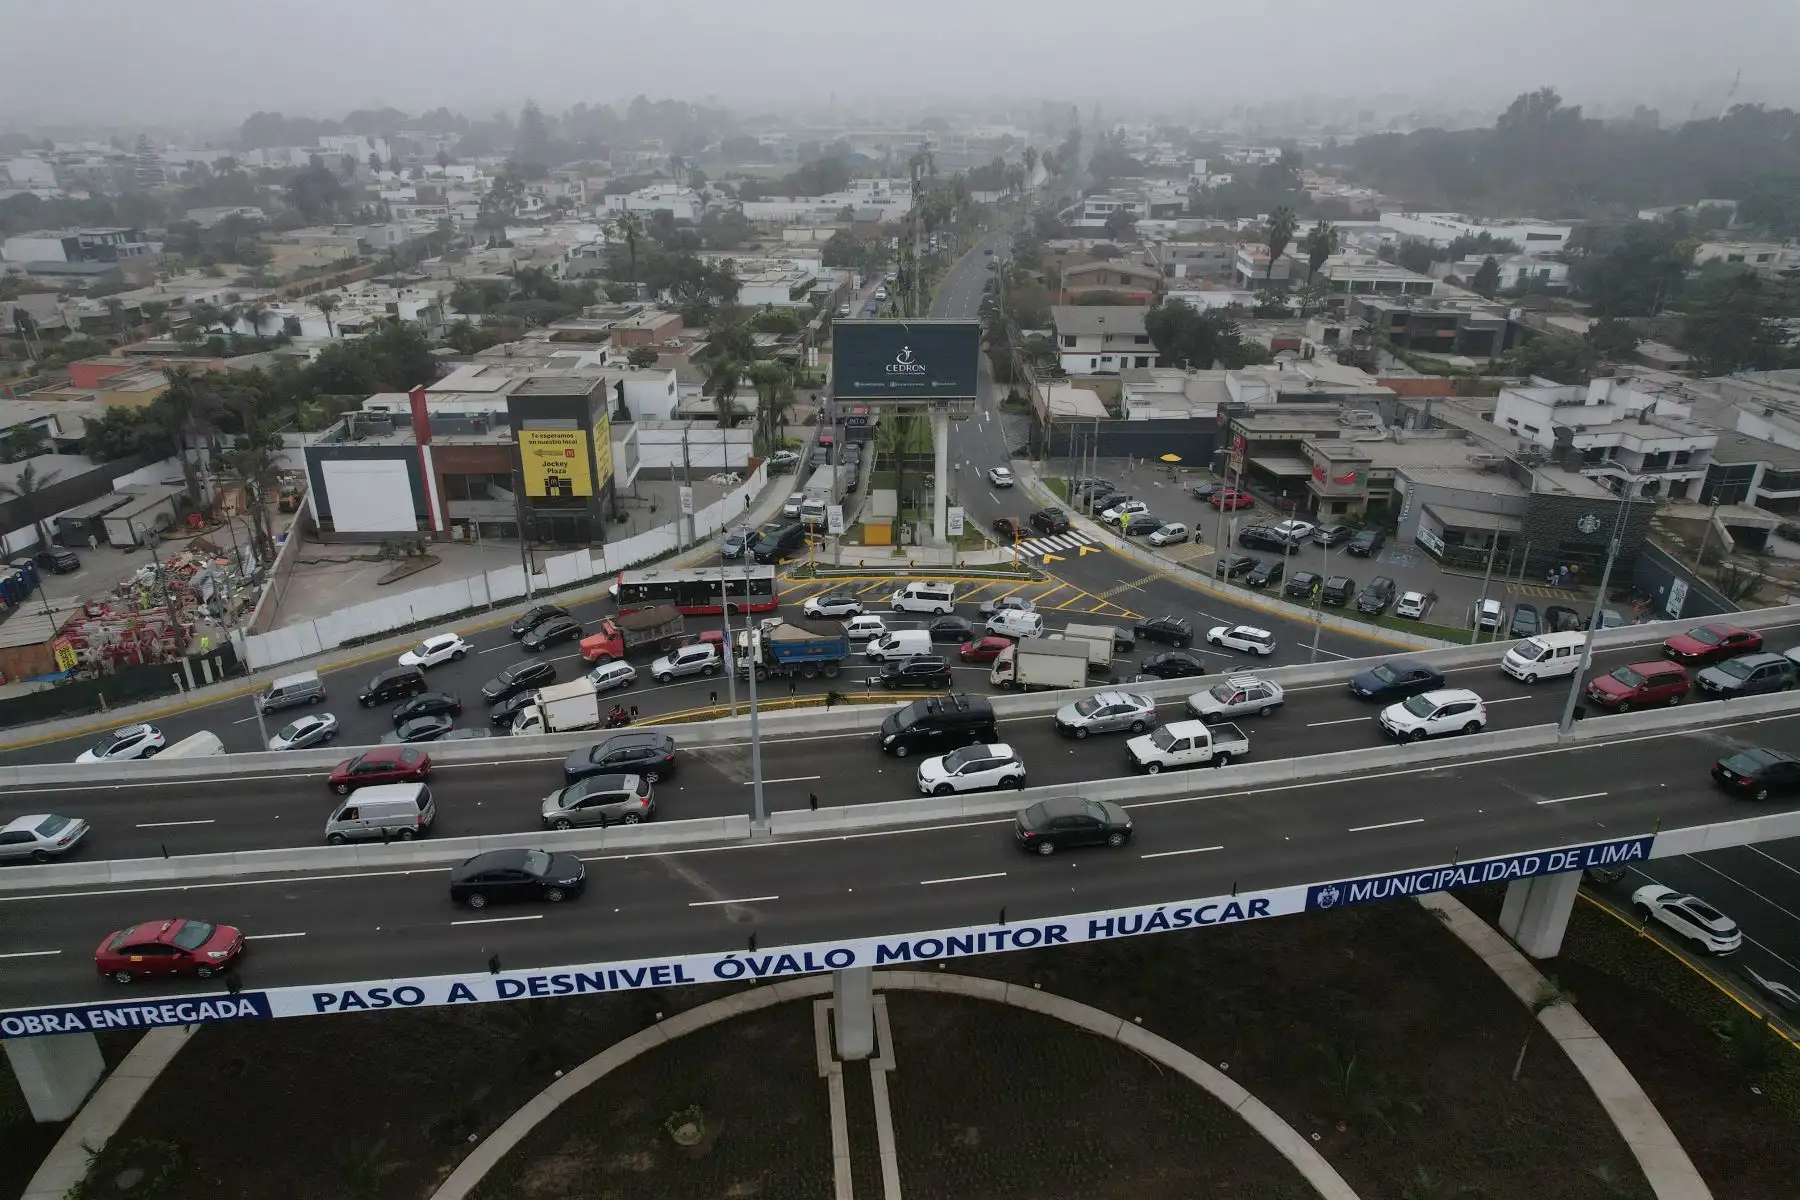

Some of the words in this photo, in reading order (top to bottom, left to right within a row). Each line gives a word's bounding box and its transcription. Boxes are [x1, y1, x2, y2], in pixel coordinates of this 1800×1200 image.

[885, 364, 926, 372] CEDRON
[1349, 856, 1540, 902] MUNICIPALIDAD
[1547, 850, 1581, 872] DE
[1586, 841, 1642, 866] LIMA
[311, 985, 426, 1013] PASO
[446, 982, 478, 1002] A
[495, 963, 696, 1000] DESNIVEL
[713, 948, 856, 980] ÓVALO
[875, 924, 1068, 965] MONITOR
[1088, 898, 1272, 939] HUÁSCAR
[1, 1012, 84, 1036] OBRA
[88, 998, 259, 1028] ENTREGADA
